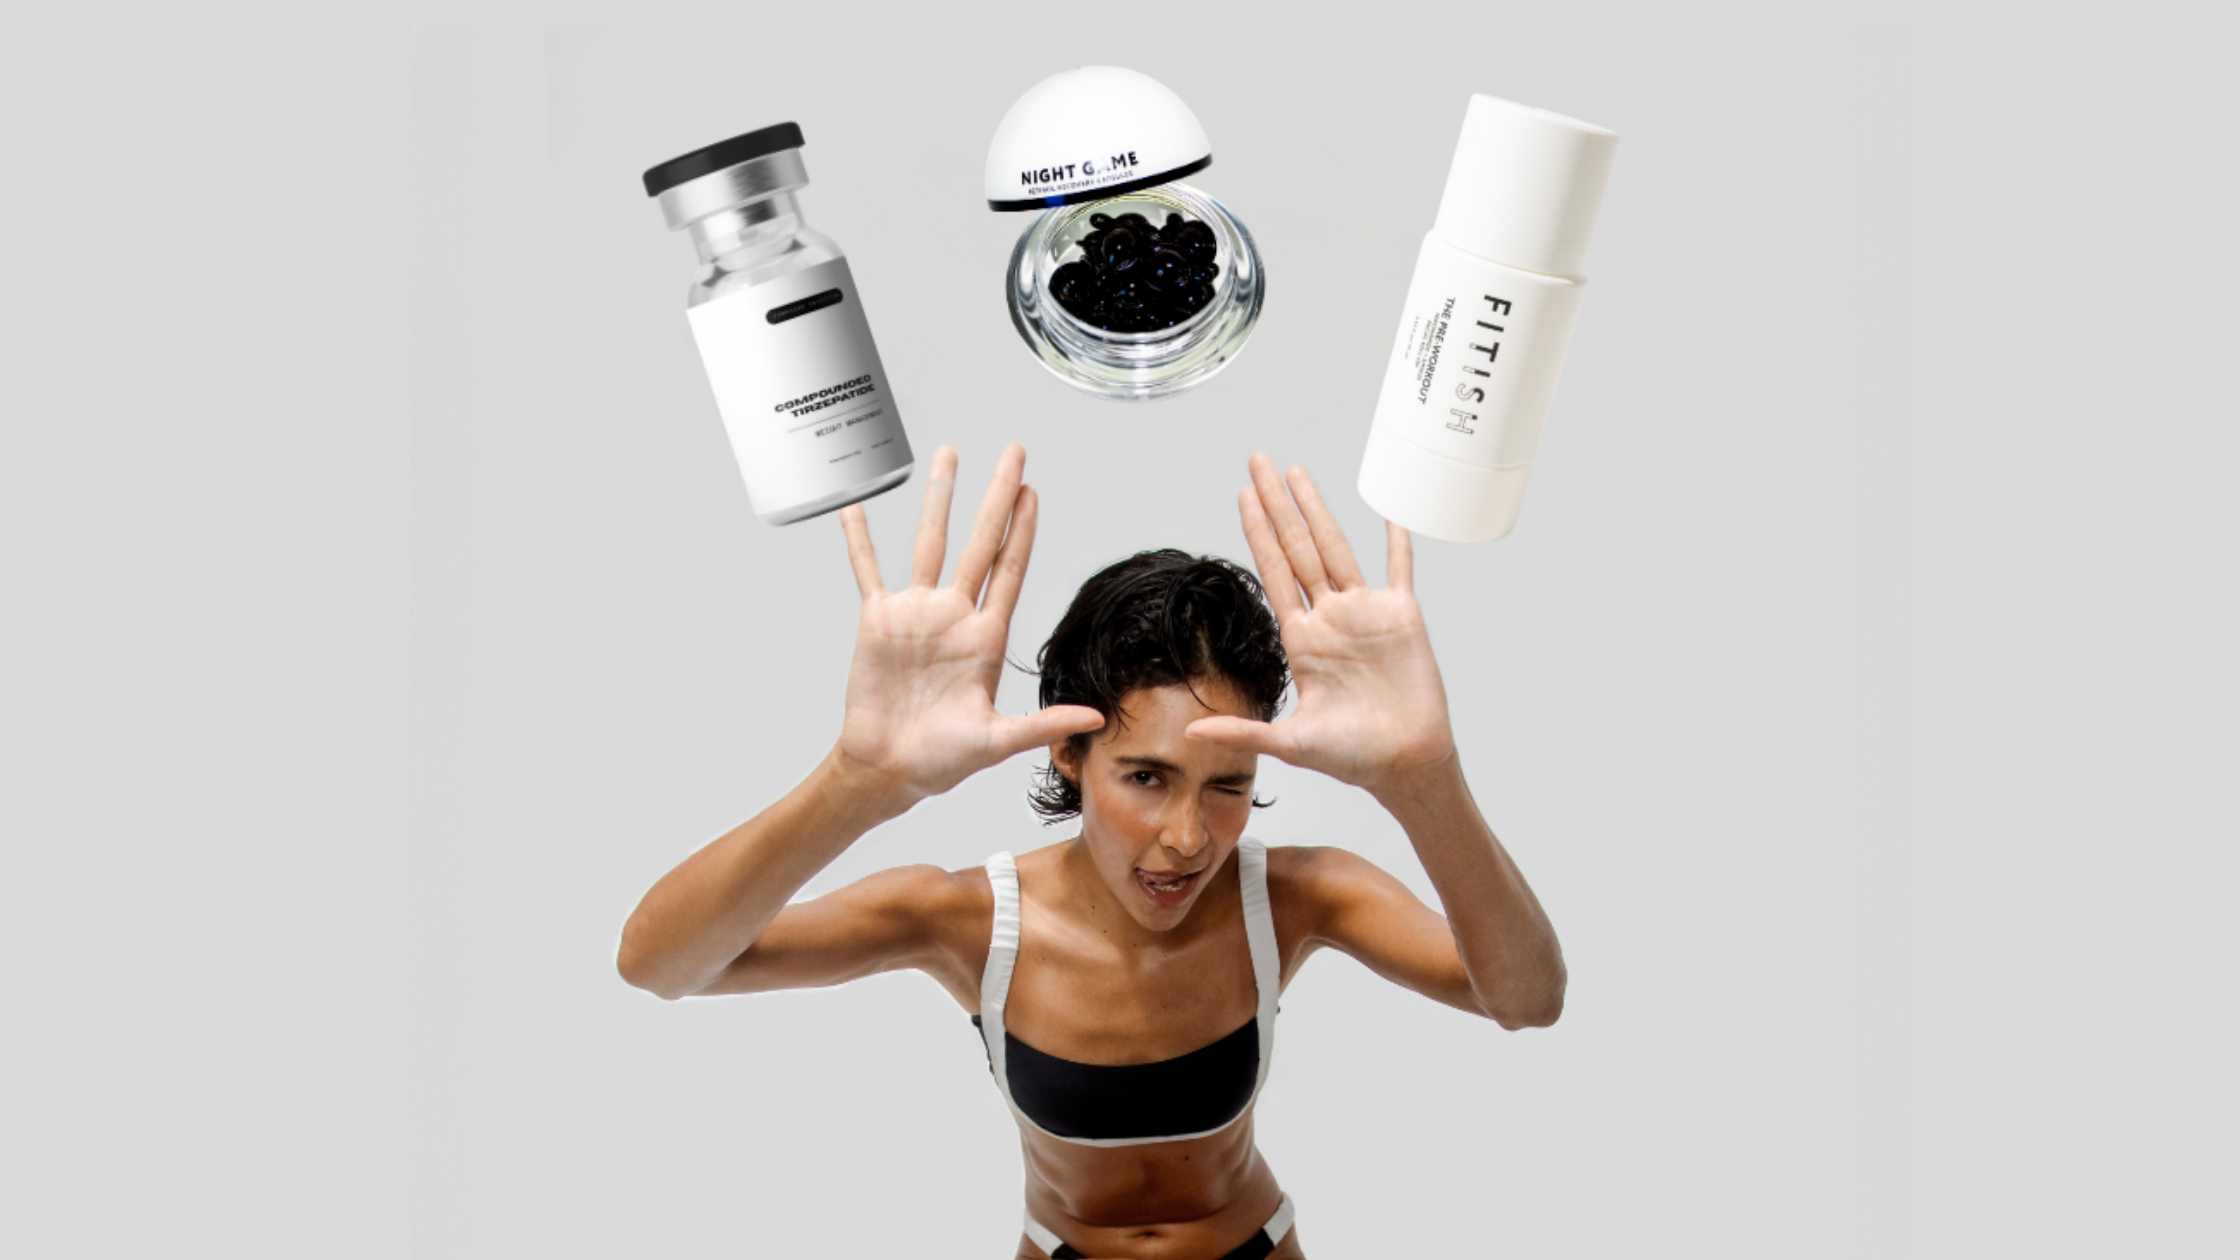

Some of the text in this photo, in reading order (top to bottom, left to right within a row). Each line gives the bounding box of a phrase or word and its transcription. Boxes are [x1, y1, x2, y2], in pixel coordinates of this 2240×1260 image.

[1021, 151, 1139, 185] NIGHT GME
[1417, 297, 1456, 405] THE PRE-WORKOUT
[1446, 294, 1512, 435] FITISH
[774, 374, 872, 413] COMPOUNDED
[791, 383, 875, 418] TIRZEPATIDE
